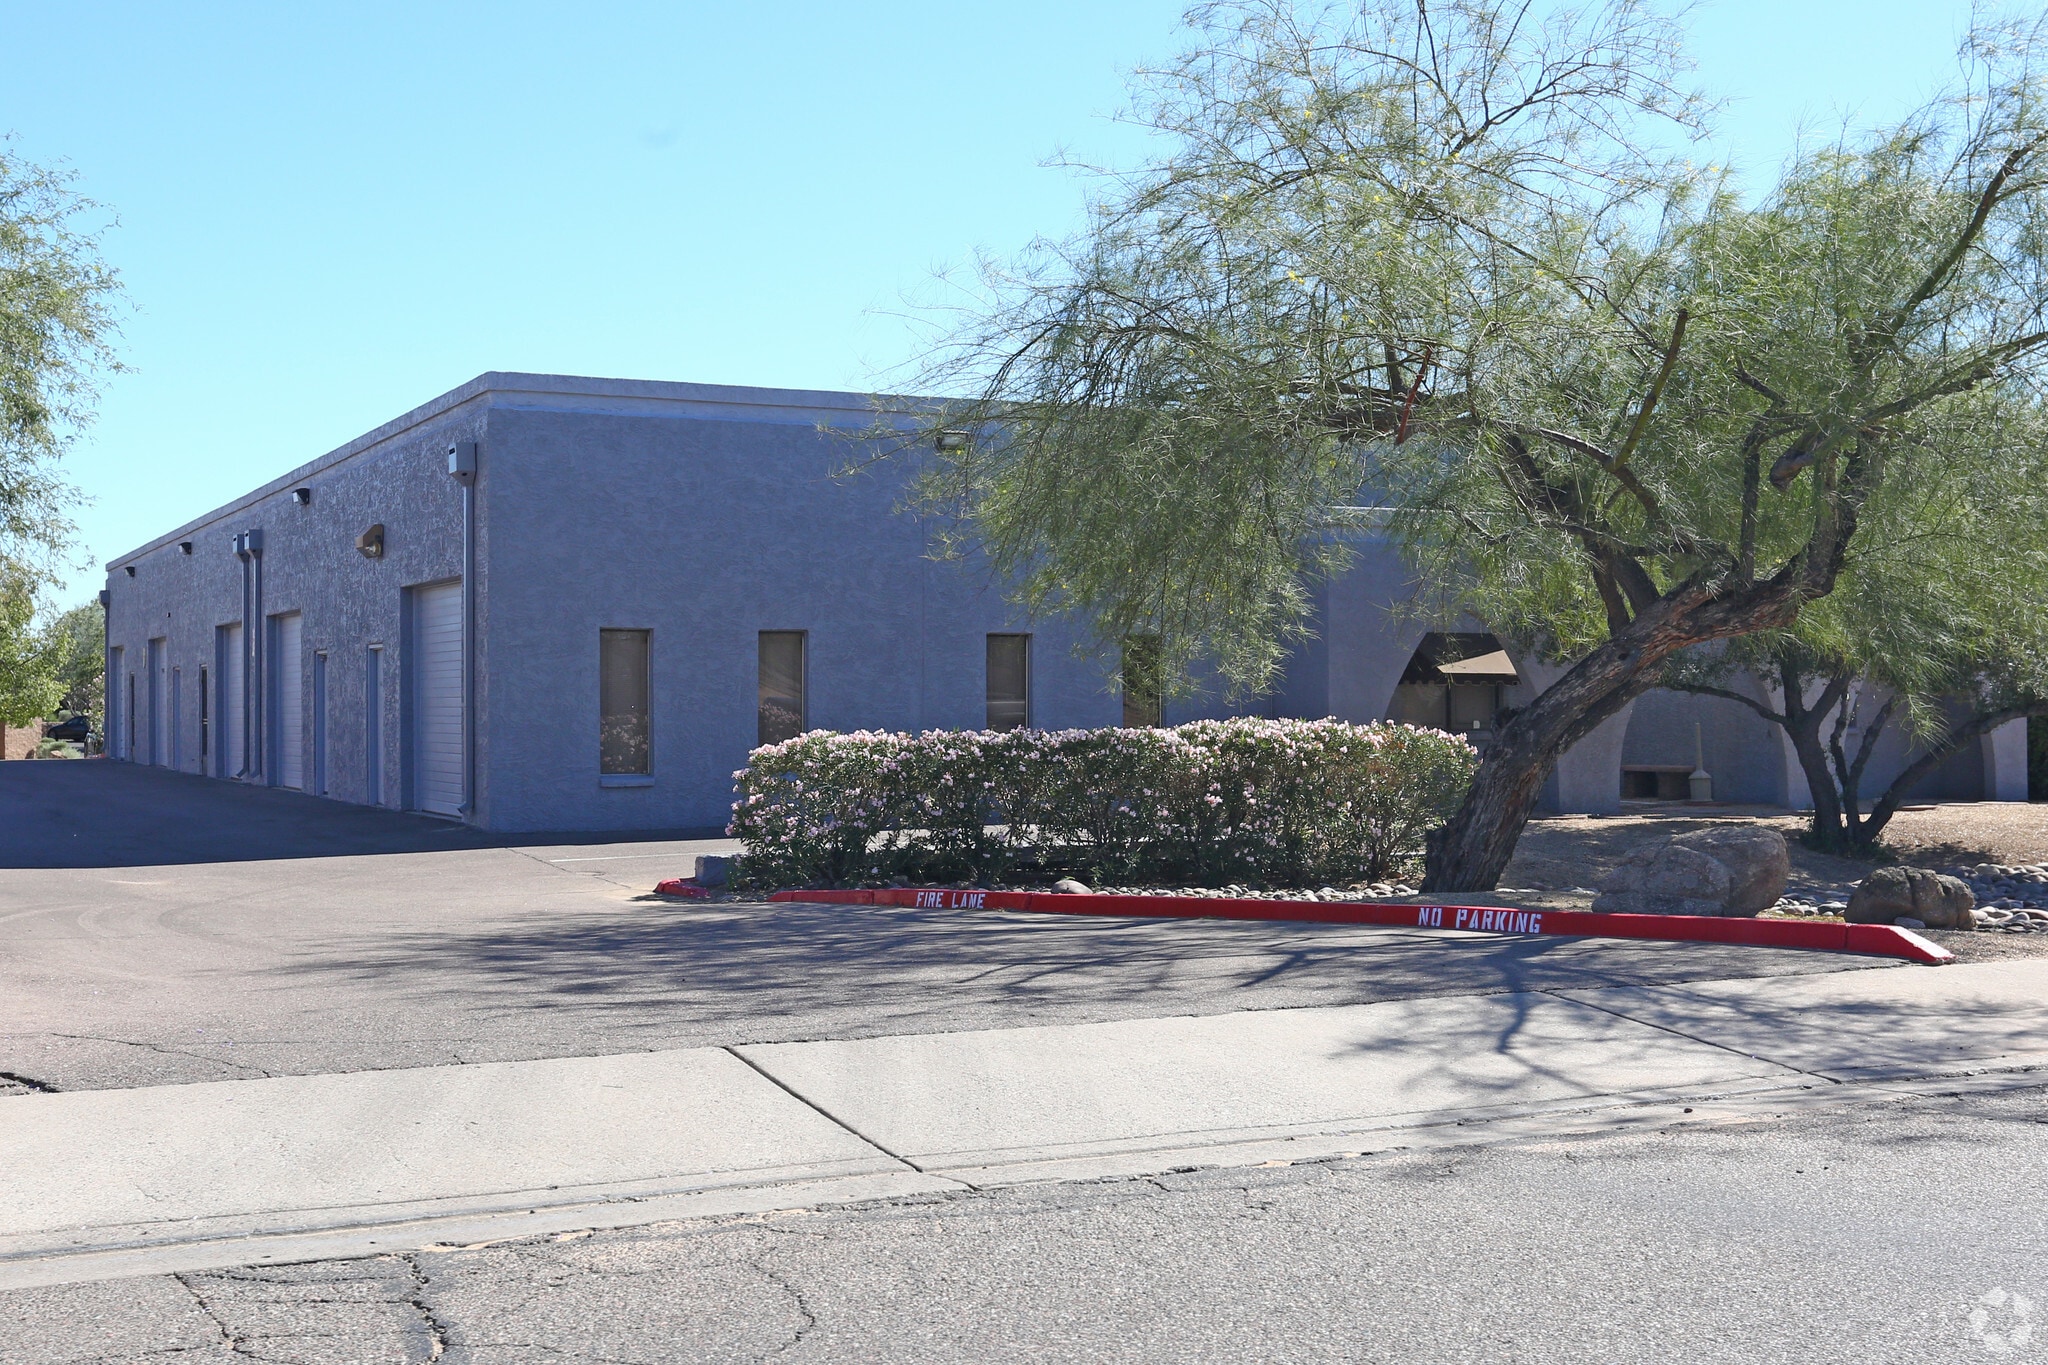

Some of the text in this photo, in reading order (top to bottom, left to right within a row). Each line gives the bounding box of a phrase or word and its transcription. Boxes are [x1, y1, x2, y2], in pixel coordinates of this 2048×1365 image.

[916, 891, 986, 909] FIRE LANE
[1418, 907, 1542, 934] NO PARKING
